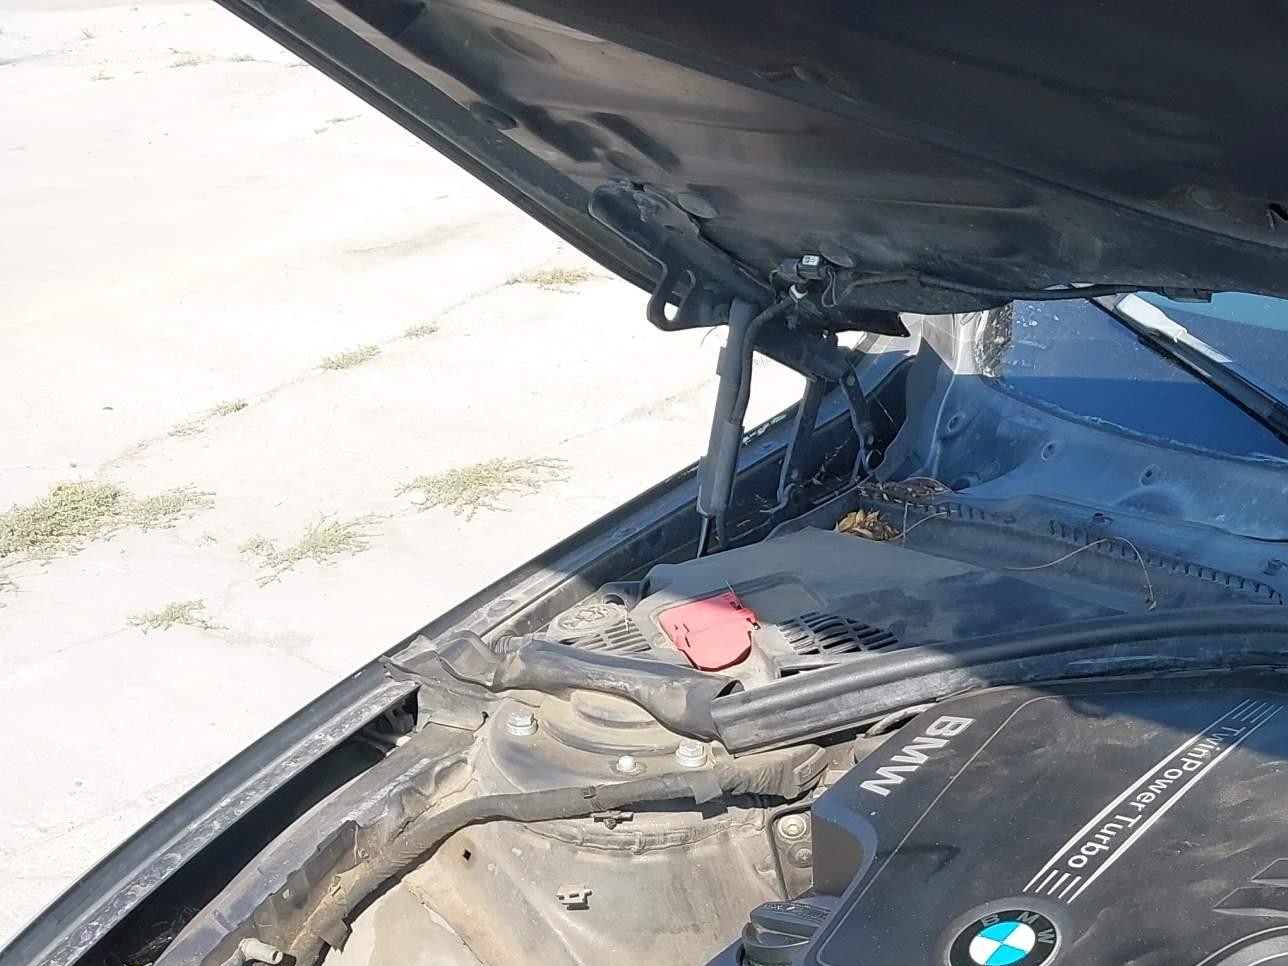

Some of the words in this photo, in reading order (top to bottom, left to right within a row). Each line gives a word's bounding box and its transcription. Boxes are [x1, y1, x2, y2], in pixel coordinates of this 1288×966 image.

[860, 715, 976, 797] BMW
[1067, 813, 1143, 869] Turbo
[980, 911, 1056, 945] BMW
